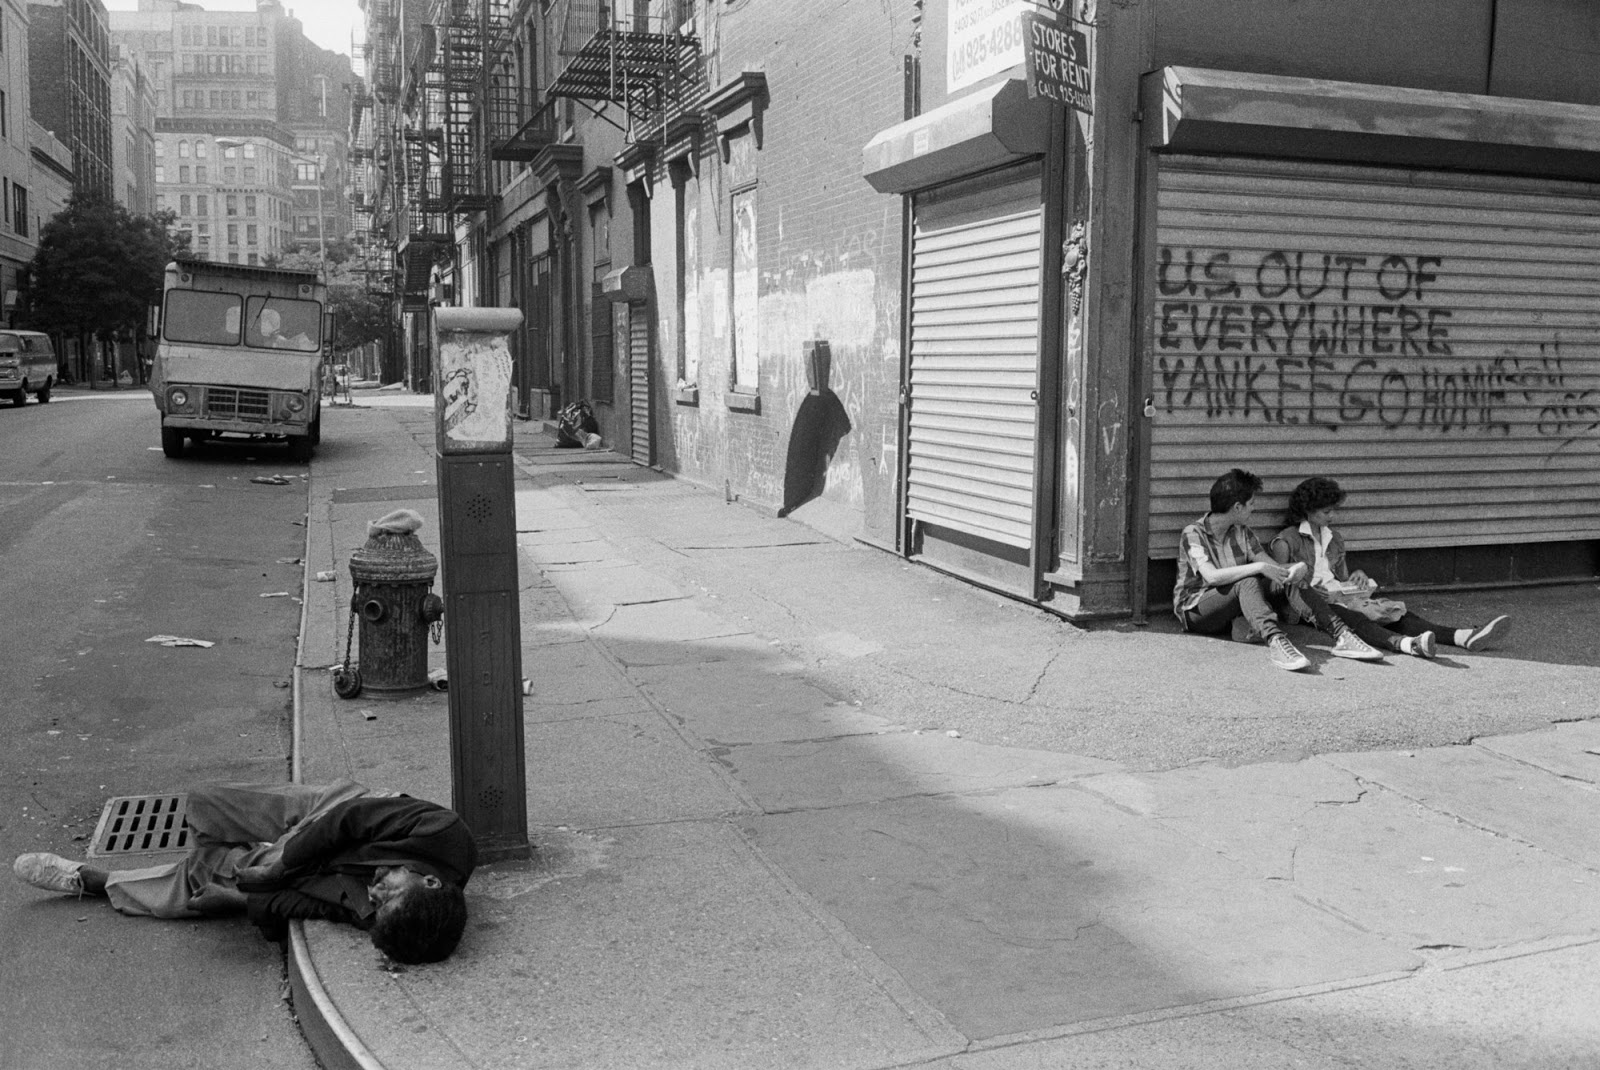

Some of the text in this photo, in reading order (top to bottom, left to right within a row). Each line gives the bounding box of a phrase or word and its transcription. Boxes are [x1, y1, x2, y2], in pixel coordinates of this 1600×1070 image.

[1032, 21, 1076, 60] STORES
[1035, 49, 1090, 91] FOR RENT
[1038, 80, 1092, 111] CALL 925-4288
[1256, 251, 1367, 300] OUT
[1376, 255, 1441, 300] OF
[1159, 302, 1453, 357] EVERYWHERE
[1159, 355, 1338, 432] YANKEE
[1339, 358, 1410, 431] GO
[1416, 364, 1510, 436] HOME
